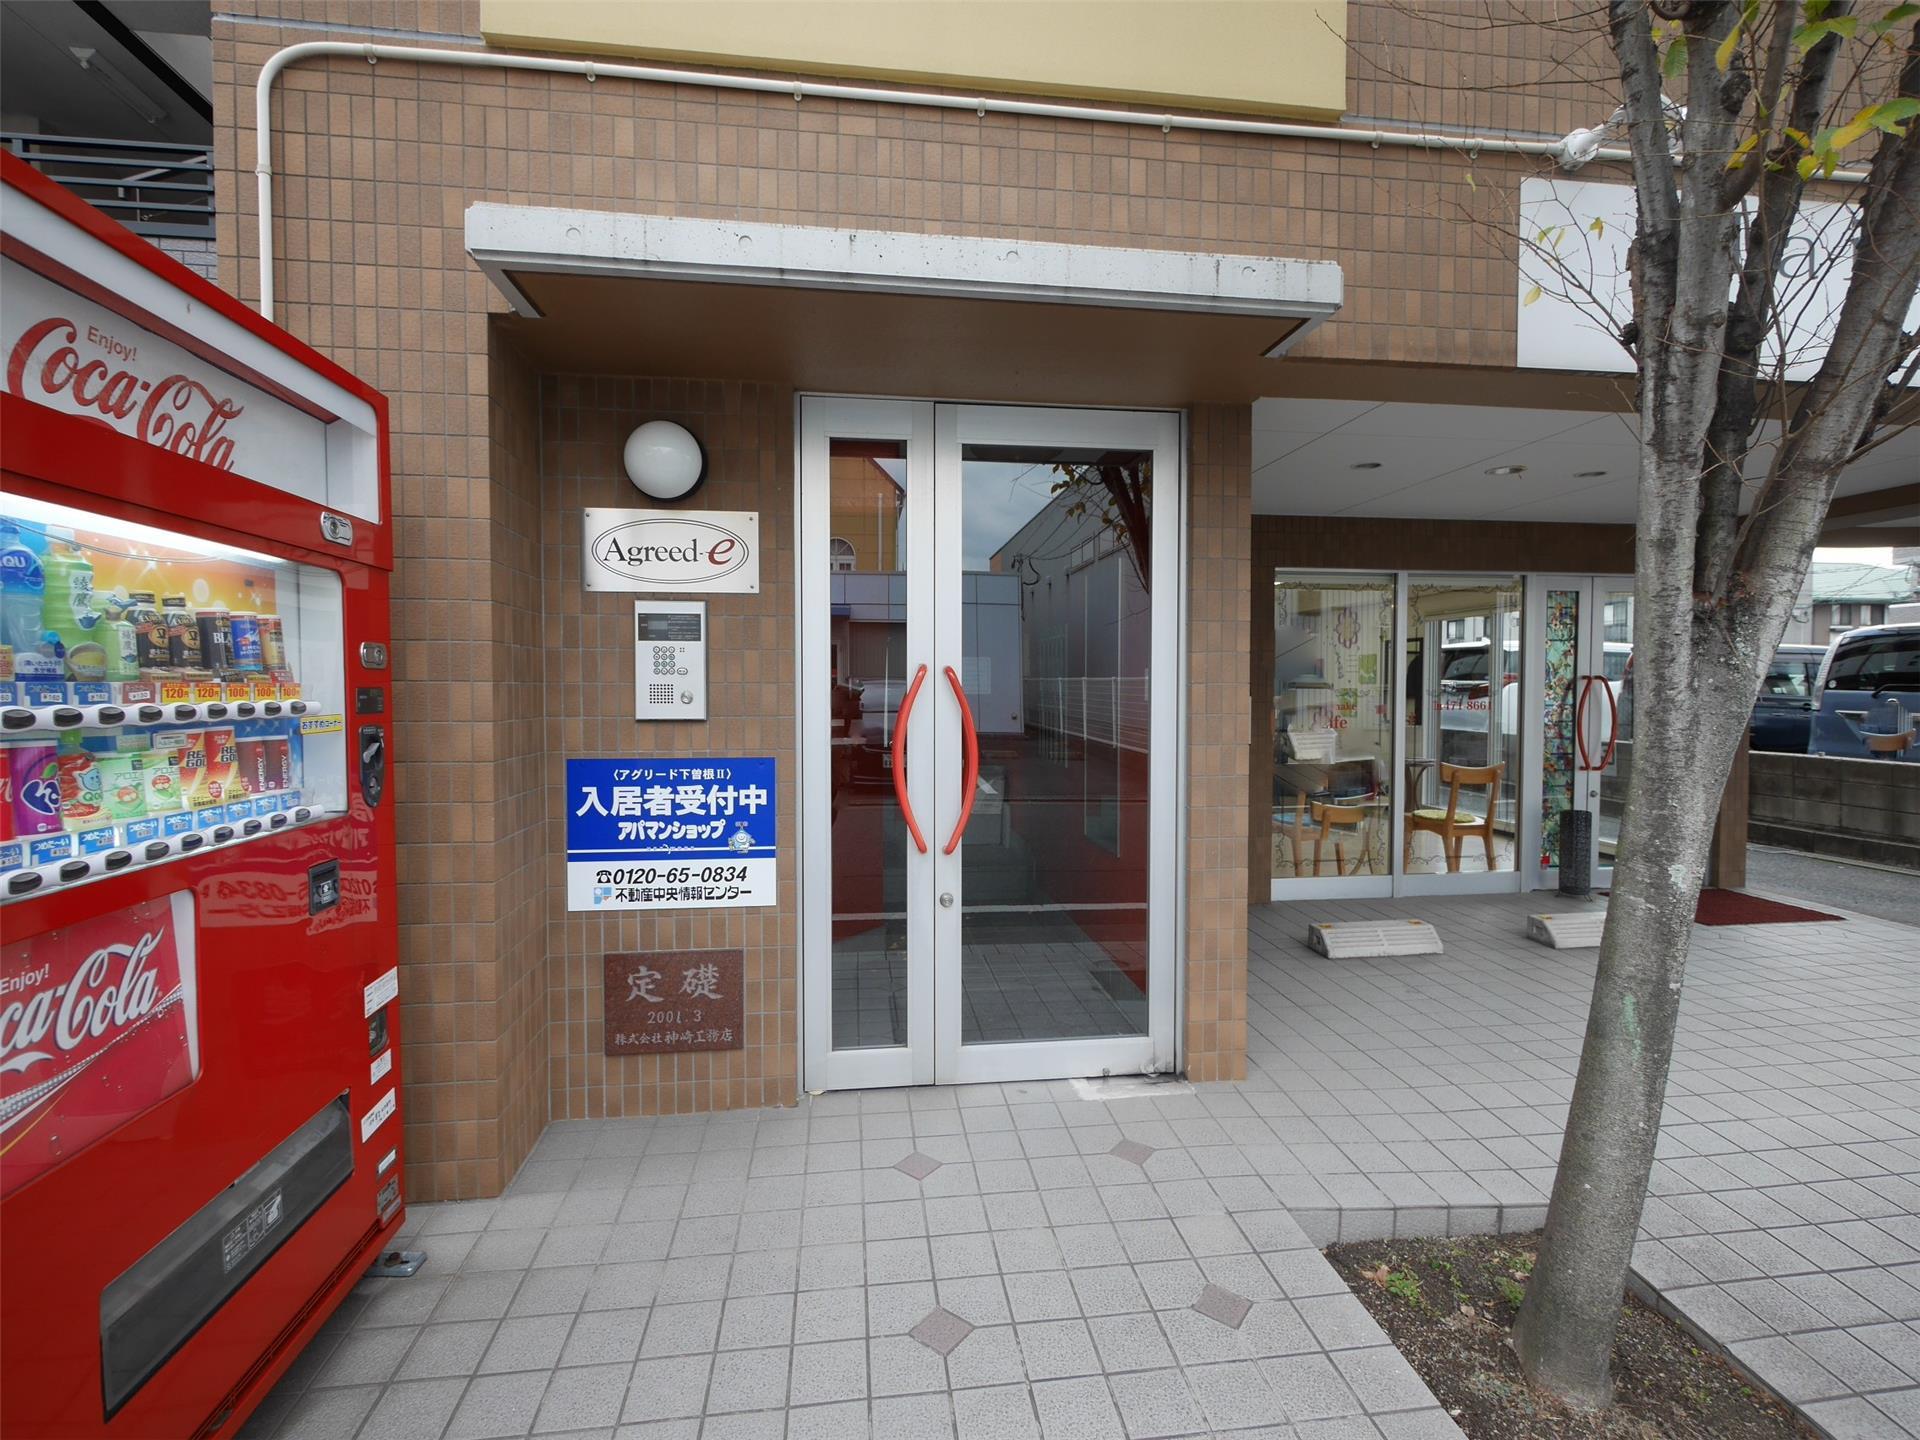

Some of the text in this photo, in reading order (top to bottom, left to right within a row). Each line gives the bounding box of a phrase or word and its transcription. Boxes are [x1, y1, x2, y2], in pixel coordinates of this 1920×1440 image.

[87, 325, 138, 361] Enjoy!
[7, 317, 244, 472] Coca-Cola
[0, 556, 26, 568] QU
[576, 785, 768, 817] 入居者受付中
[618, 820, 725, 841] アパマンショップ
[613, 866, 748, 884] 0120-65-0834
[615, 886, 752, 902] 不動産中央情報センター
[0, 963, 50, 995] Enjoy!
